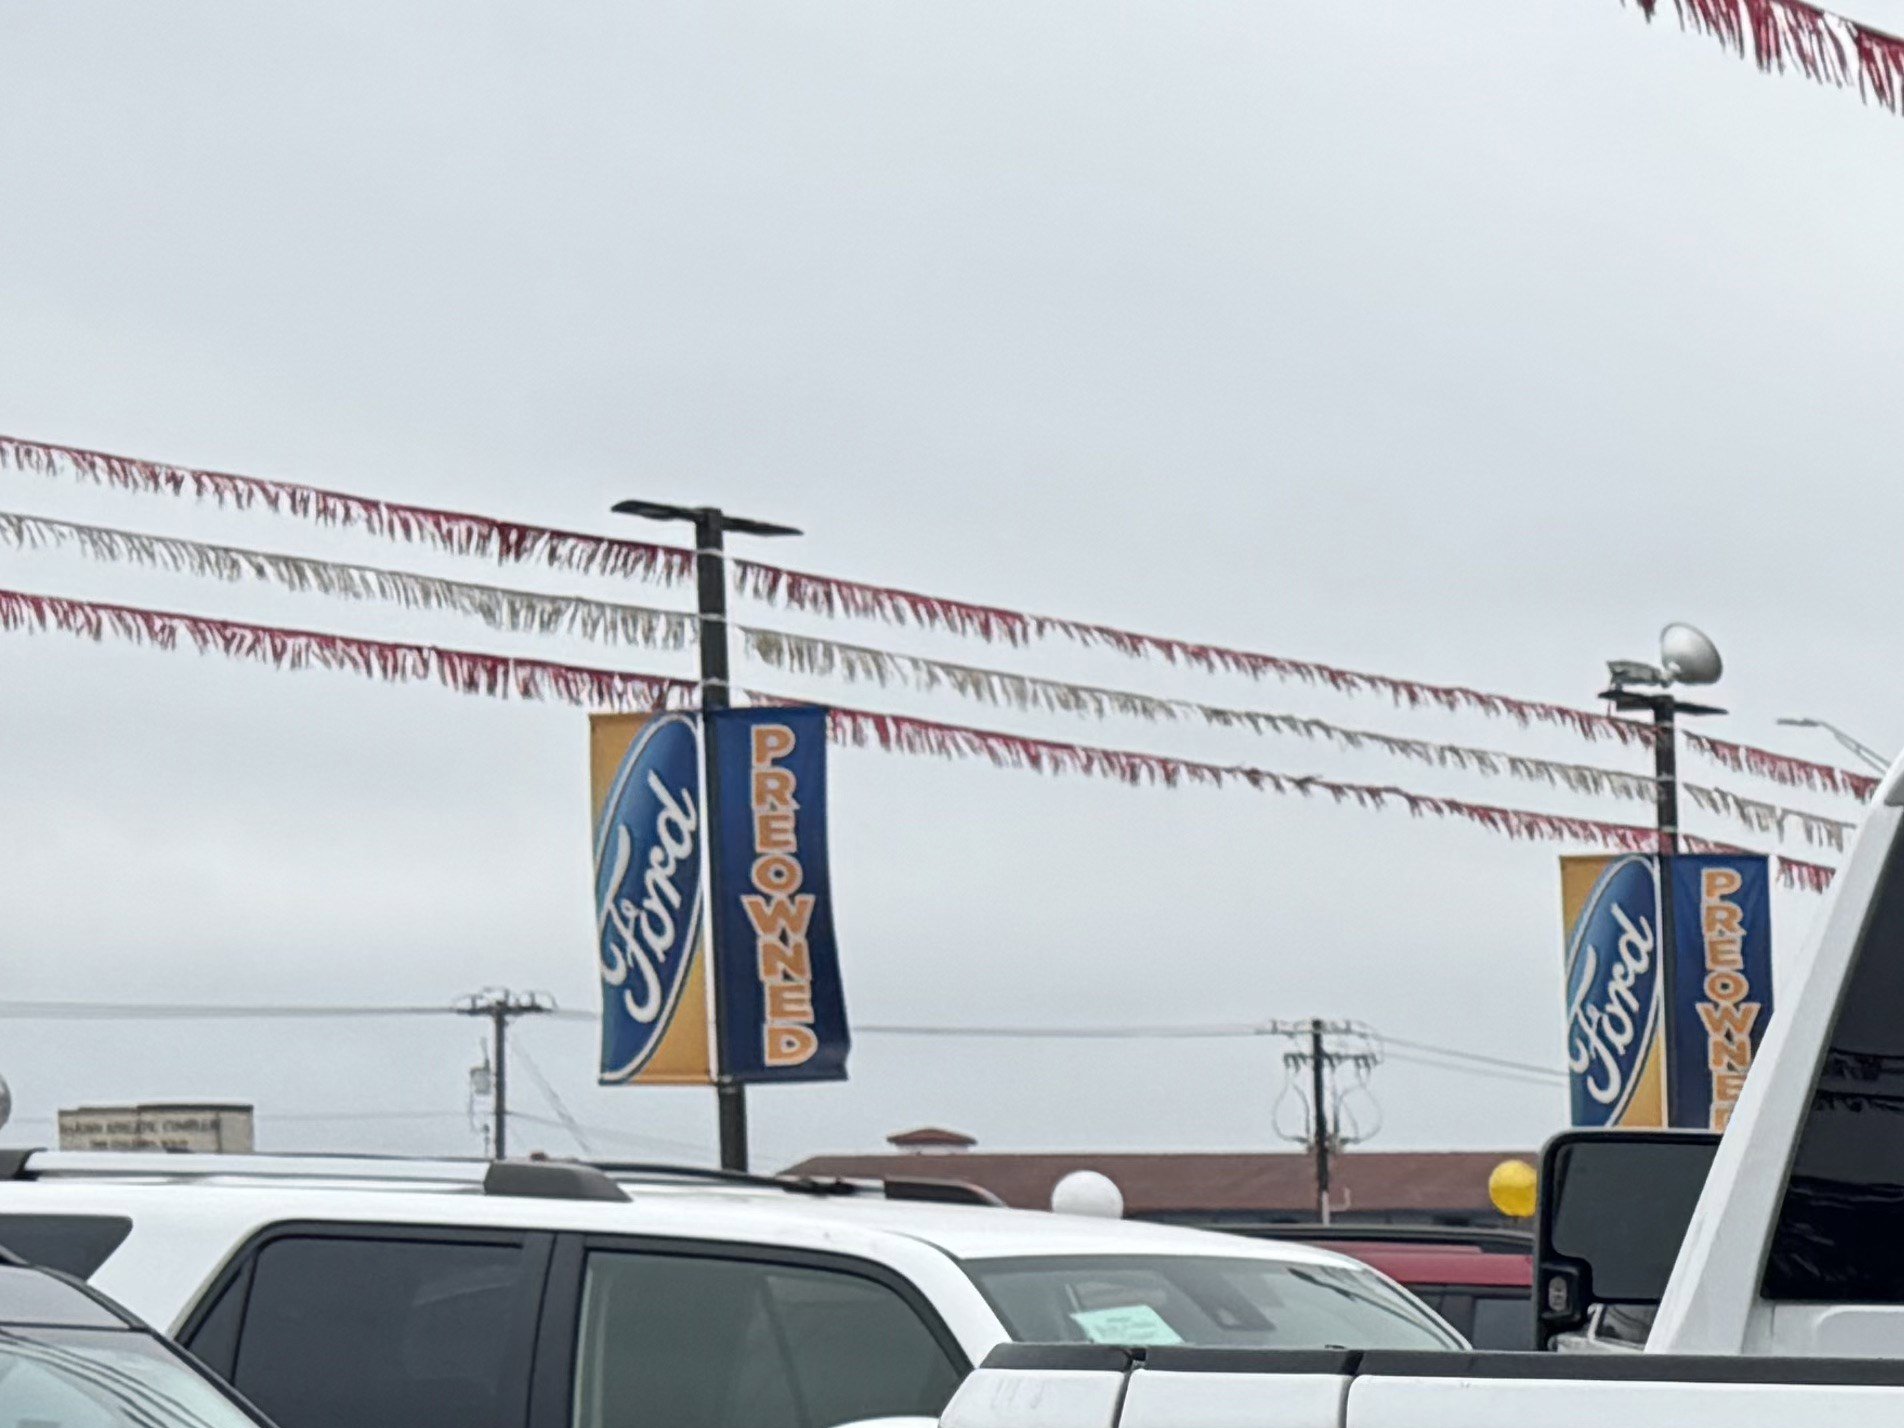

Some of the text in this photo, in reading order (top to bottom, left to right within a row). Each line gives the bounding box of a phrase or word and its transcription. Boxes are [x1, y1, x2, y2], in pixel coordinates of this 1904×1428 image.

[600, 771, 698, 1024] Ford
[740, 724, 819, 1067] PREOWNED
[1568, 903, 1654, 1104] Ford
